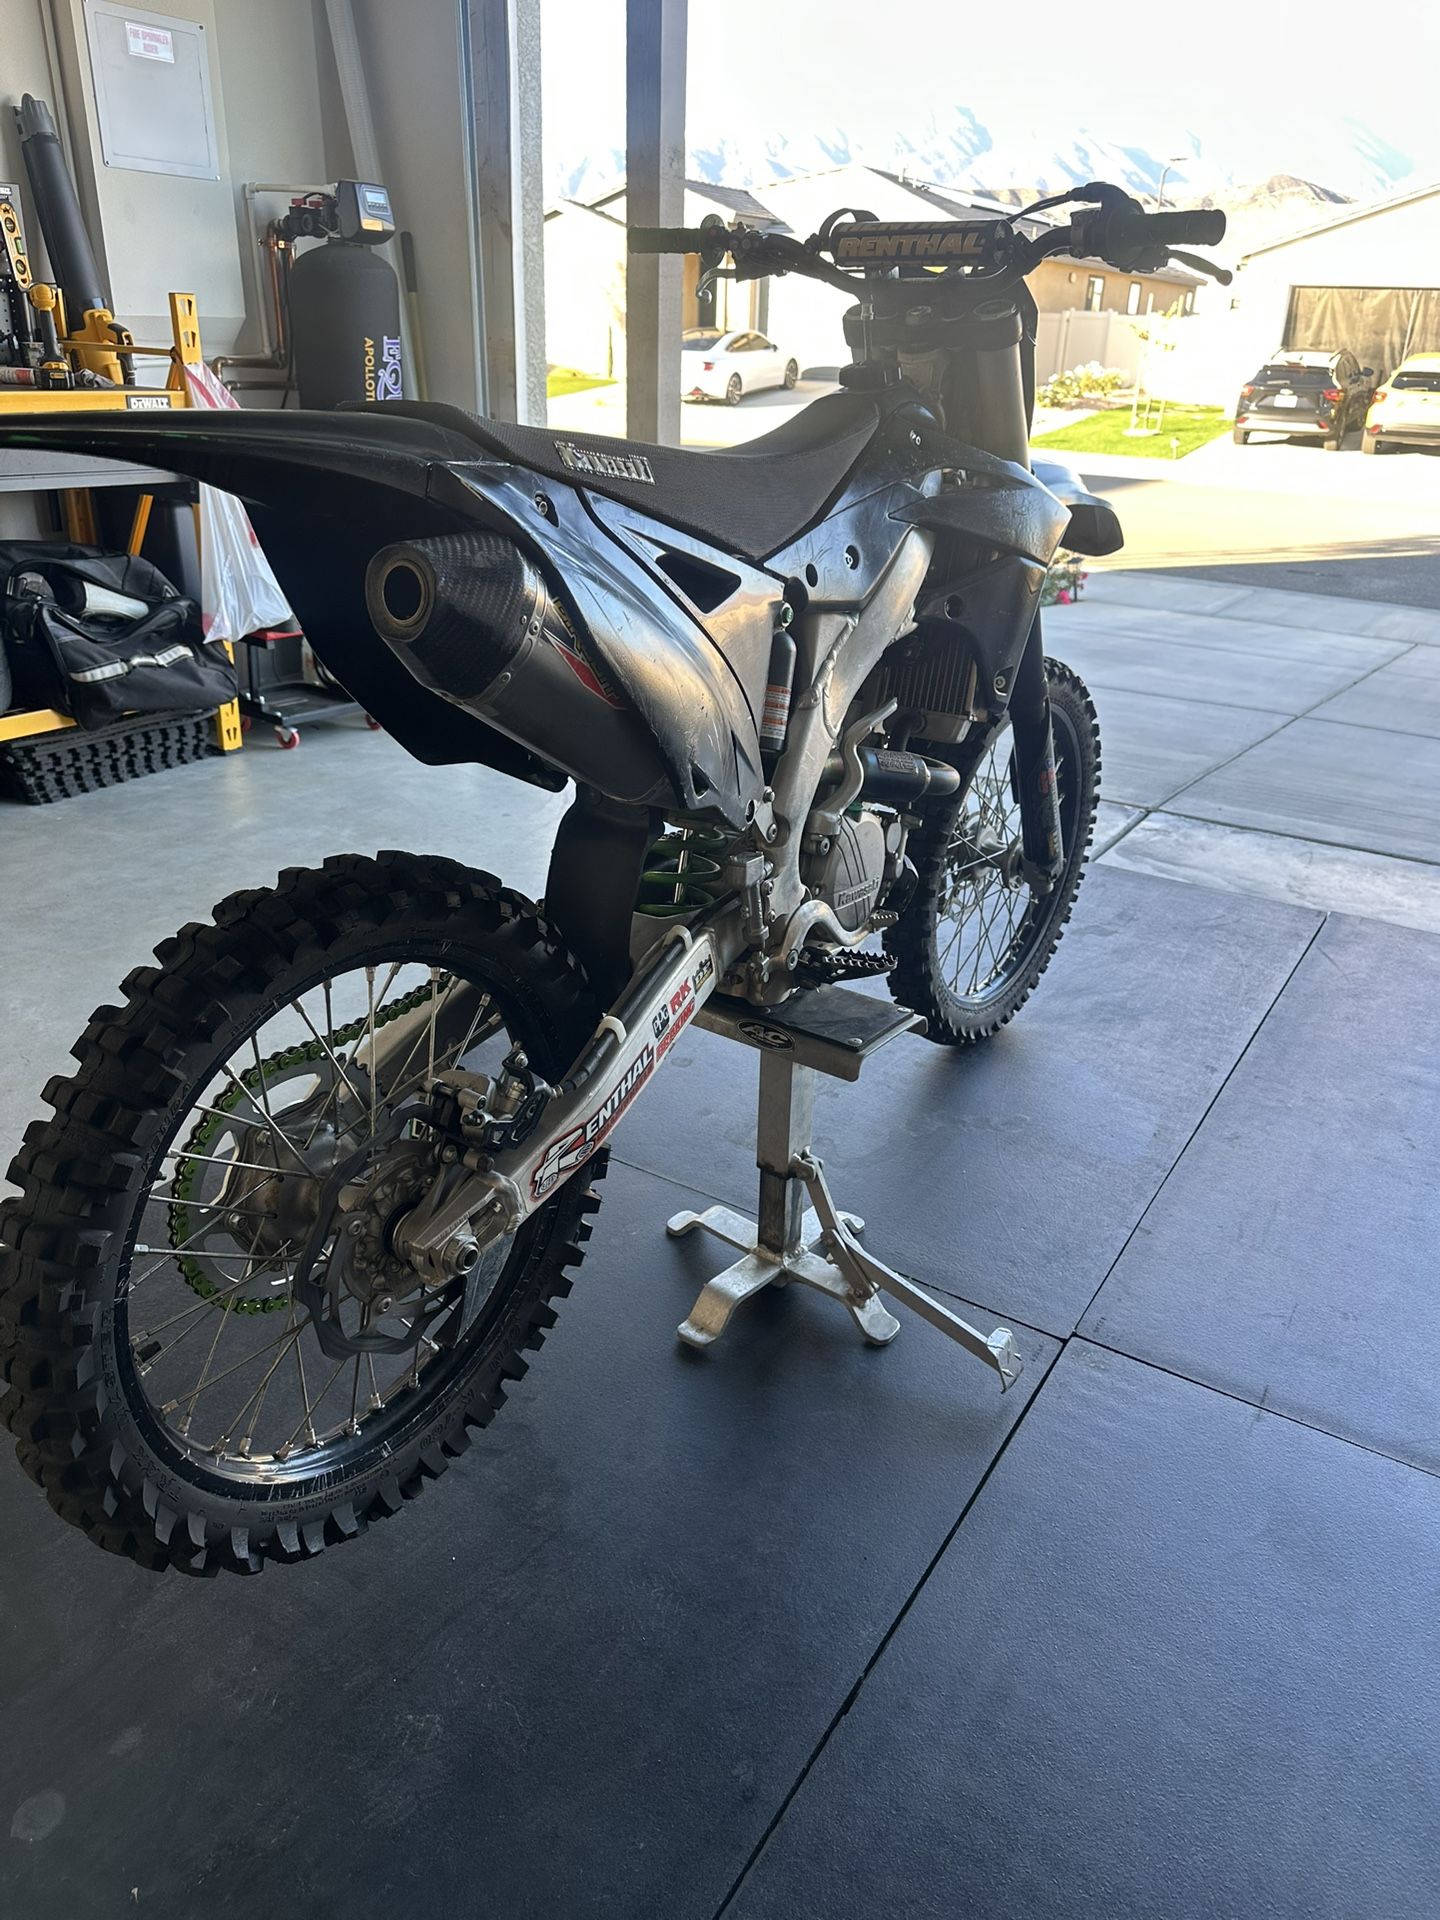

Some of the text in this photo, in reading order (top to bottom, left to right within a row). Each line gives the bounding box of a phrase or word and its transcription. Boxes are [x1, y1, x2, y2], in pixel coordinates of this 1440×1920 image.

[837, 232, 984, 257] RENTHAL
[670, 977, 691, 1015] RK
[652, 1004, 669, 1038] PPG
